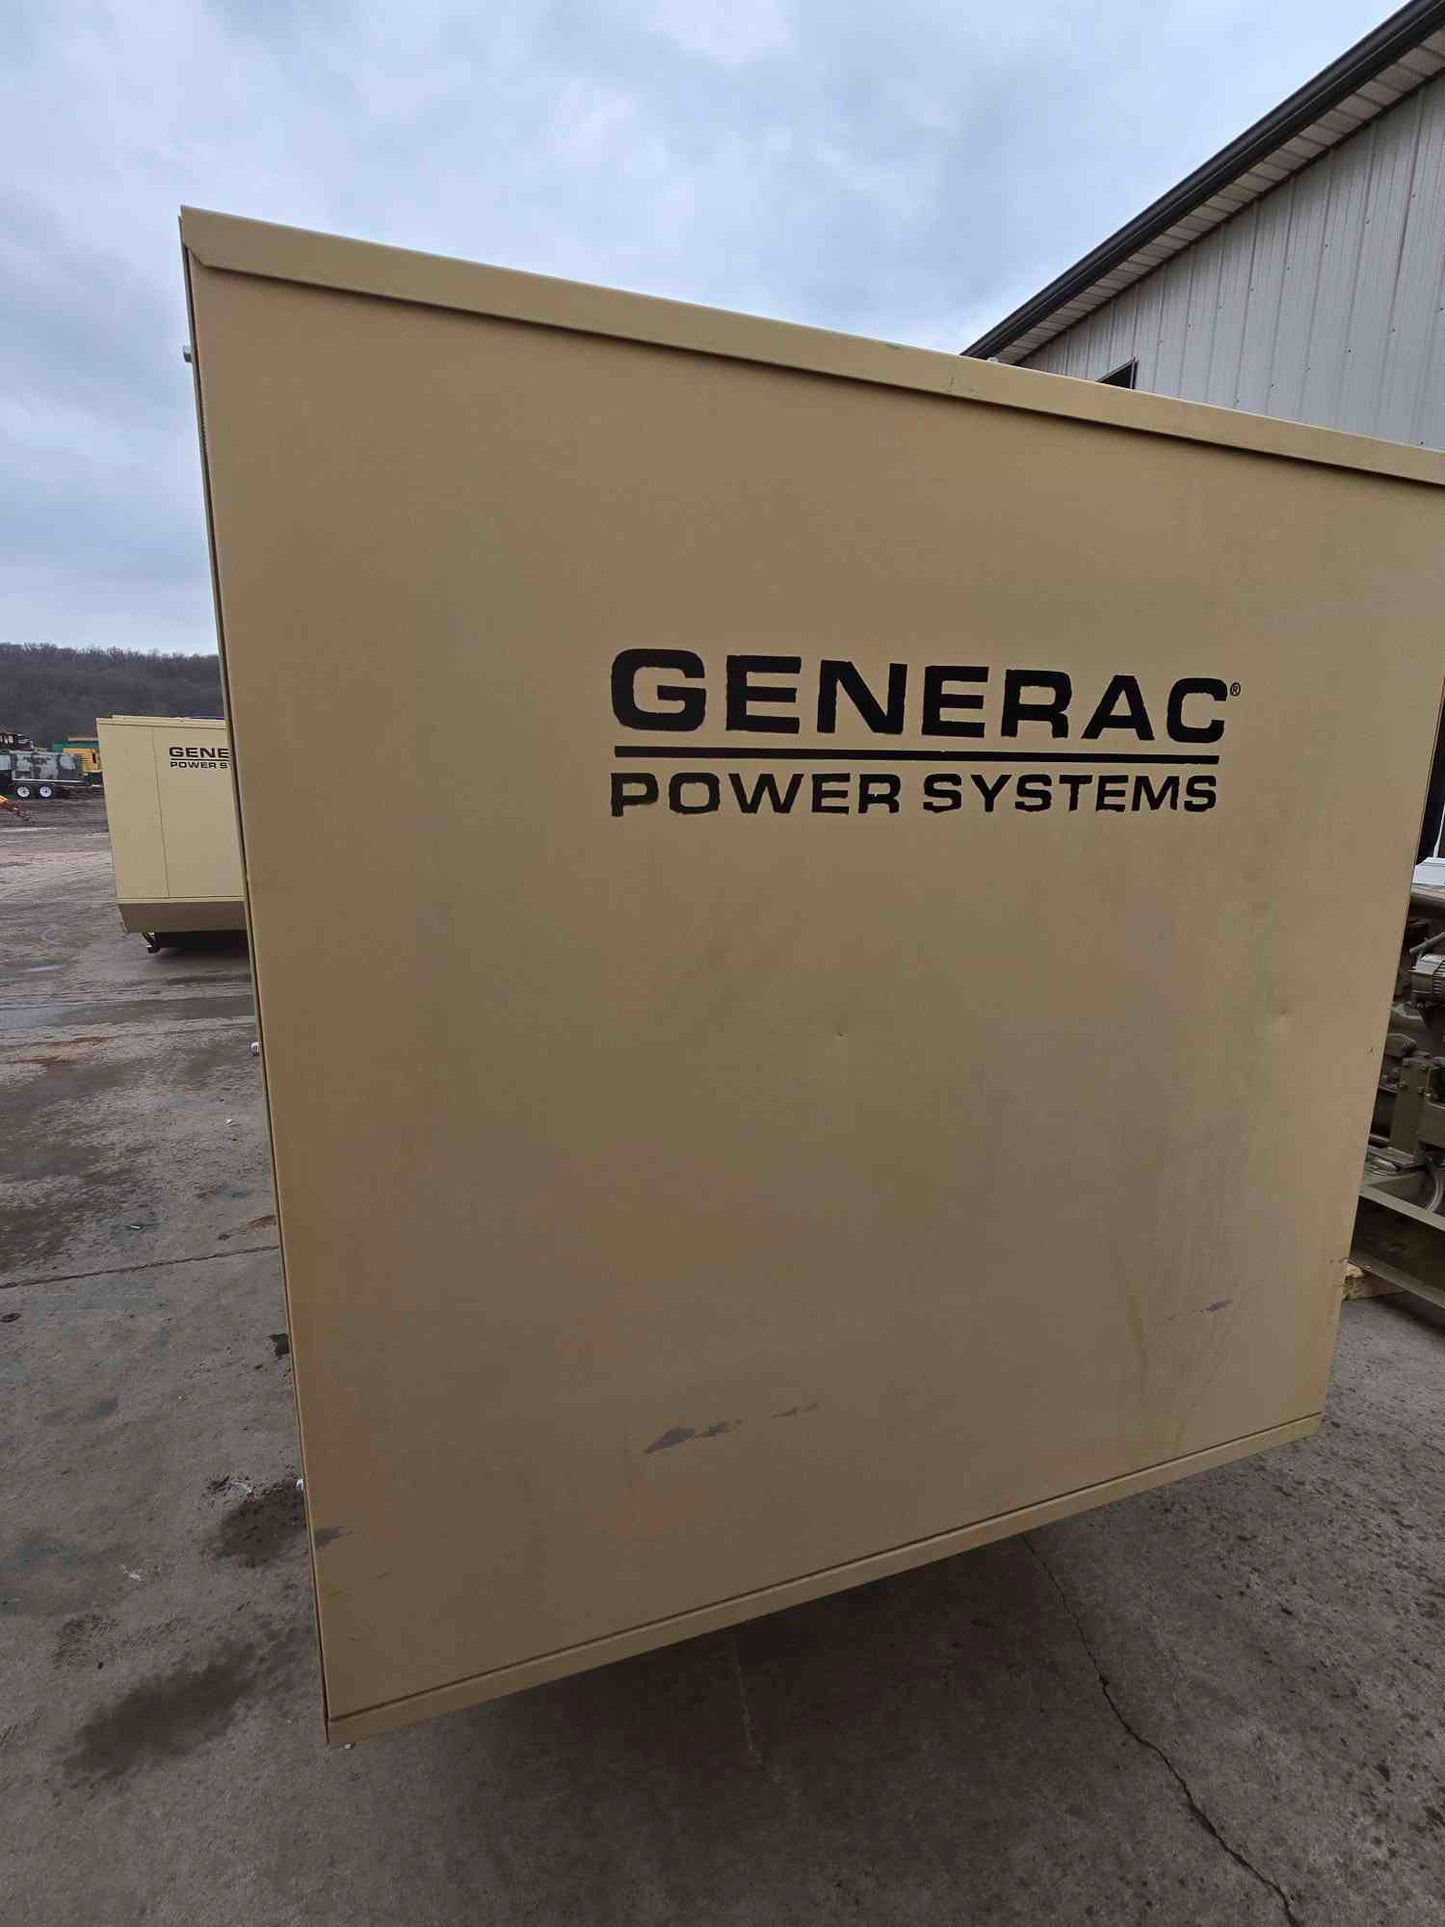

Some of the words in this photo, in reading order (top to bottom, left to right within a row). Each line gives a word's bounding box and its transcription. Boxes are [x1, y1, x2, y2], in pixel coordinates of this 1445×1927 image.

[170, 761, 217, 769] POWER
[610, 772, 901, 818] POWER
[922, 773, 1217, 814] SYSTEMS
